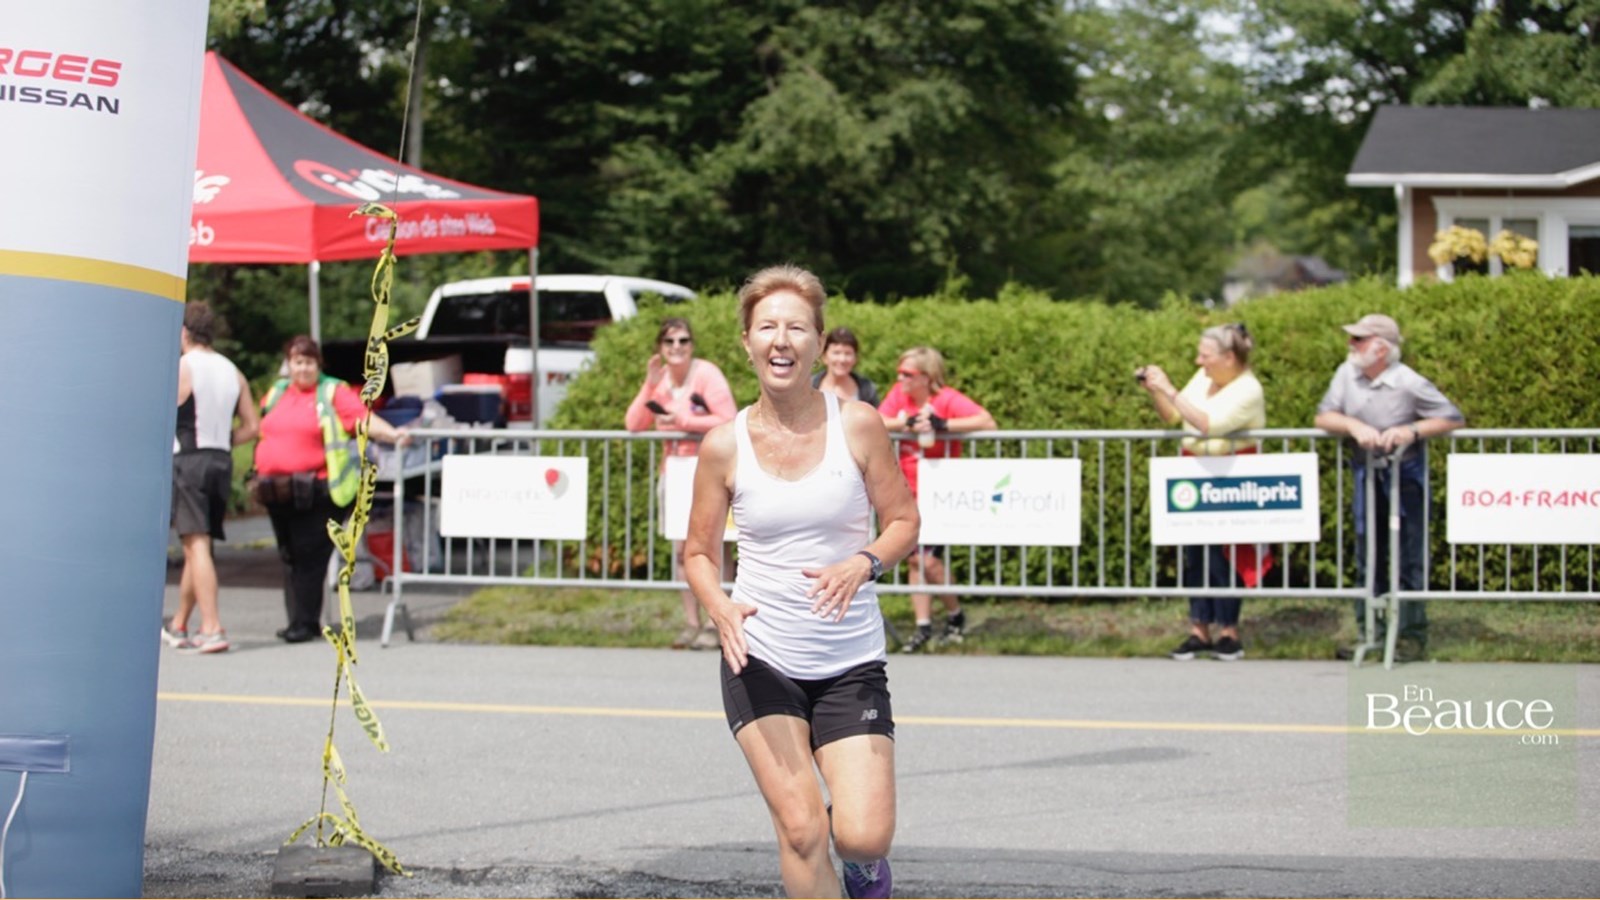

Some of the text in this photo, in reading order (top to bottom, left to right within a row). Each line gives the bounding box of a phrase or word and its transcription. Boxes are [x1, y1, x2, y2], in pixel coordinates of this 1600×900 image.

[0, 84, 119, 115] ISSAN
[365, 216, 418, 241] Créion
[420, 214, 438, 237] de
[932, 490, 1065, 512] MAB Profil
[1201, 480, 1298, 507] familiprix
